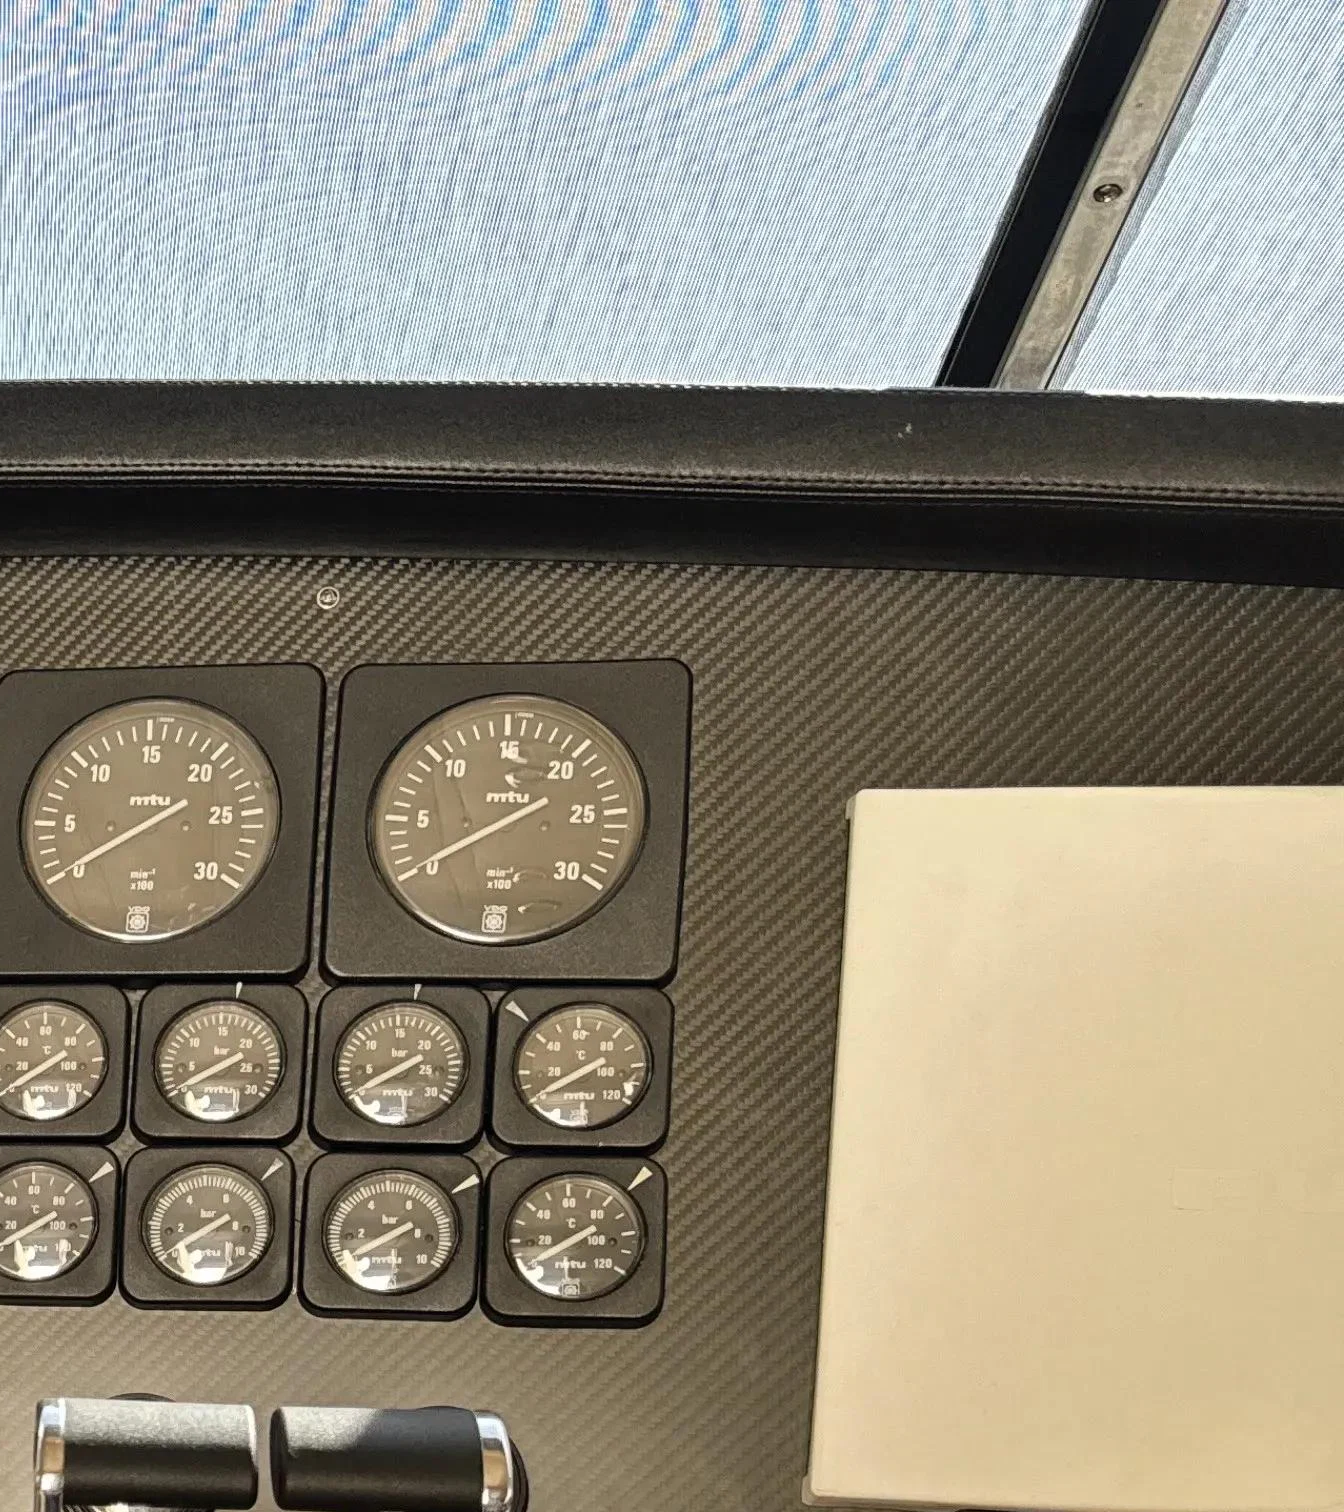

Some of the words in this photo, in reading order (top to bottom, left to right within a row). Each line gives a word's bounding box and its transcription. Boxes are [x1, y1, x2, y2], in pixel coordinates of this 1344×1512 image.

[143, 745, 160, 763] 15
[91, 764, 110, 782] 10
[188, 764, 212, 782] 20
[445, 760, 466, 777] 10
[548, 761, 573, 779] 20
[130, 795, 170, 806] mtu
[486, 792, 529, 803] mtu
[209, 806, 233, 824] 25
[570, 805, 595, 823] 25
[65, 814, 75, 832] 5
[417, 810, 429, 828] 5
[73, 862, 85, 878] 0
[194, 862, 218, 880] 30
[427, 861, 438, 875] 0
[554, 862, 579, 880] 30
[130, 881, 153, 890] x100
[487, 880, 511, 889] x100
[218, 1027, 228, 1036] 15
[395, 1028, 405, 1038] 15
[573, 1030, 586, 1040] 60
[16, 1037, 28, 1046] 40
[65, 1037, 76, 1046] 80
[190, 1038, 199, 1047] 10
[240, 1039, 252, 1048] 20
[366, 1041, 376, 1050] 10
[418, 1040, 431, 1050] 20
[600, 1041, 613, 1051] 80
[214, 1046, 230, 1055] bar
[547, 1042, 560, 1051] 40
[392, 1048, 408, 1057] bar
[16, 1061, 28, 1070] 20
[61, 1061, 76, 1070] 100
[189, 1062, 195, 1071] 5
[240, 1063, 252, 1072] 25
[366, 1064, 373, 1073] 5
[419, 1065, 432, 1074] 25
[548, 1067, 560, 1076] 20
[597, 1067, 614, 1076] 100
[245, 1085, 257, 1094] 30
[383, 1088, 412, 1096] mtu
[424, 1087, 437, 1096] 30
[564, 1092, 594, 1100] mtu
[603, 1090, 620, 1099] 120
[4, 1196, 16, 1205] 40
[53, 1196, 65, 1205] 80
[187, 1195, 192, 1204] 4
[562, 1198, 576, 1208] 60
[368, 1201, 375, 1210] 4
[201, 1209, 216, 1218] bar
[537, 1210, 550, 1219] 40
[591, 1210, 604, 1219] 80
[382, 1214, 398, 1224] bar
[5, 1221, 16, 1229] 20
[50, 1221, 65, 1230] 100
[177, 1223, 184, 1232] 2
[358, 1229, 364, 1238] 2
[539, 1235, 551, 1245] 20
[588, 1236, 605, 1245] 100
[55, 1243, 71, 1251] 10
[235, 1247, 245, 1256] 10
[416, 1254, 427, 1264] 10
[594, 1259, 612, 1268] 120
